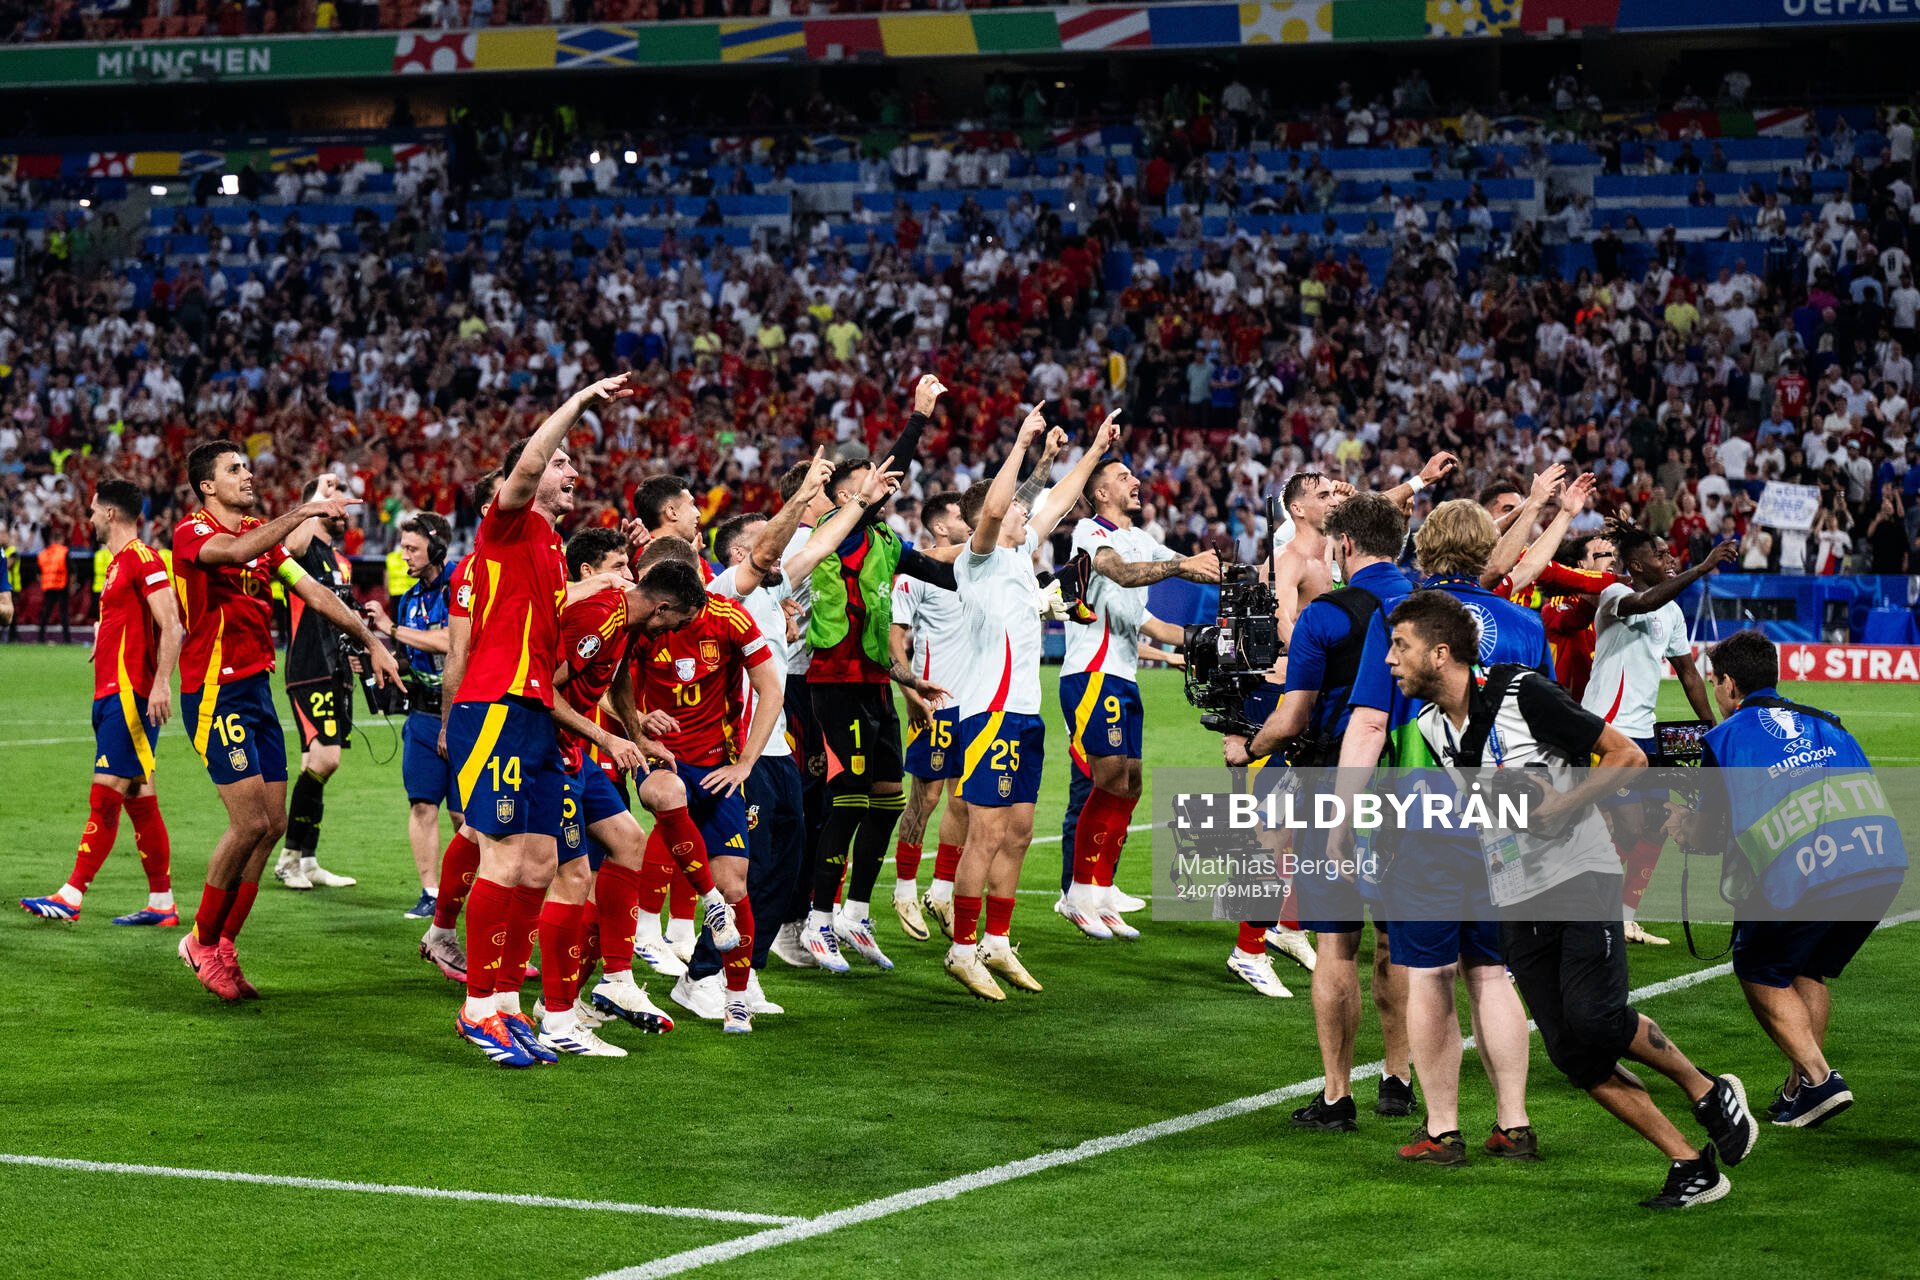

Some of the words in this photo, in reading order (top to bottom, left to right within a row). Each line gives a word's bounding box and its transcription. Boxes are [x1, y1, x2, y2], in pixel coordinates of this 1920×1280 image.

[1783, 0, 1920, 16] UEFAE
[239, 568, 261, 597] 16
[1824, 647, 1920, 681] STRA
[672, 682, 702, 707] 10
[1103, 695, 1122, 724] 9
[213, 712, 246, 747] 16
[849, 719, 861, 749] 1
[929, 720, 953, 749] 15
[990, 738, 1021, 772] 25
[1785, 739, 1812, 753] UEFA
[487, 755, 523, 792] 14
[1789, 759, 1828, 778] GERMAN
[1761, 783, 1847, 850] UEFA
[1840, 778, 1886, 810] TV
[1795, 824, 1884, 877] 09-17
